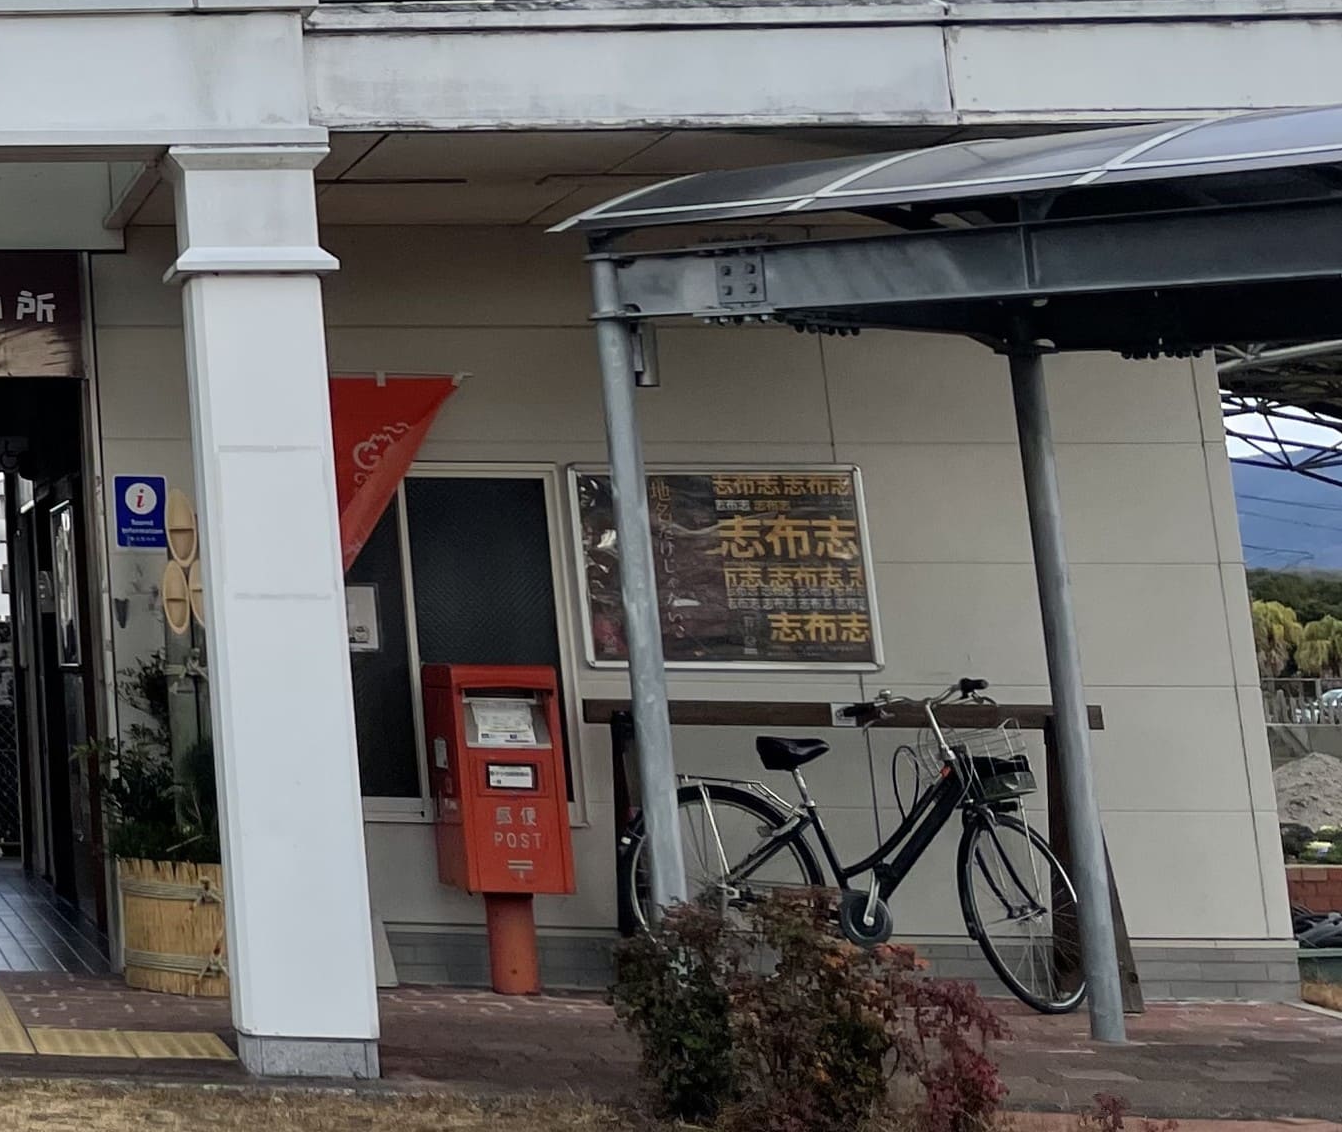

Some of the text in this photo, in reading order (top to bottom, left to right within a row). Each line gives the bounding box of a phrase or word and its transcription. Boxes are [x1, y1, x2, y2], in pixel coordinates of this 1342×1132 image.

[717, 515, 859, 560] 志布志
[767, 611, 870, 644] 志布志
[496, 806, 537, 826] 郵便
[494, 832, 542, 850] POST
